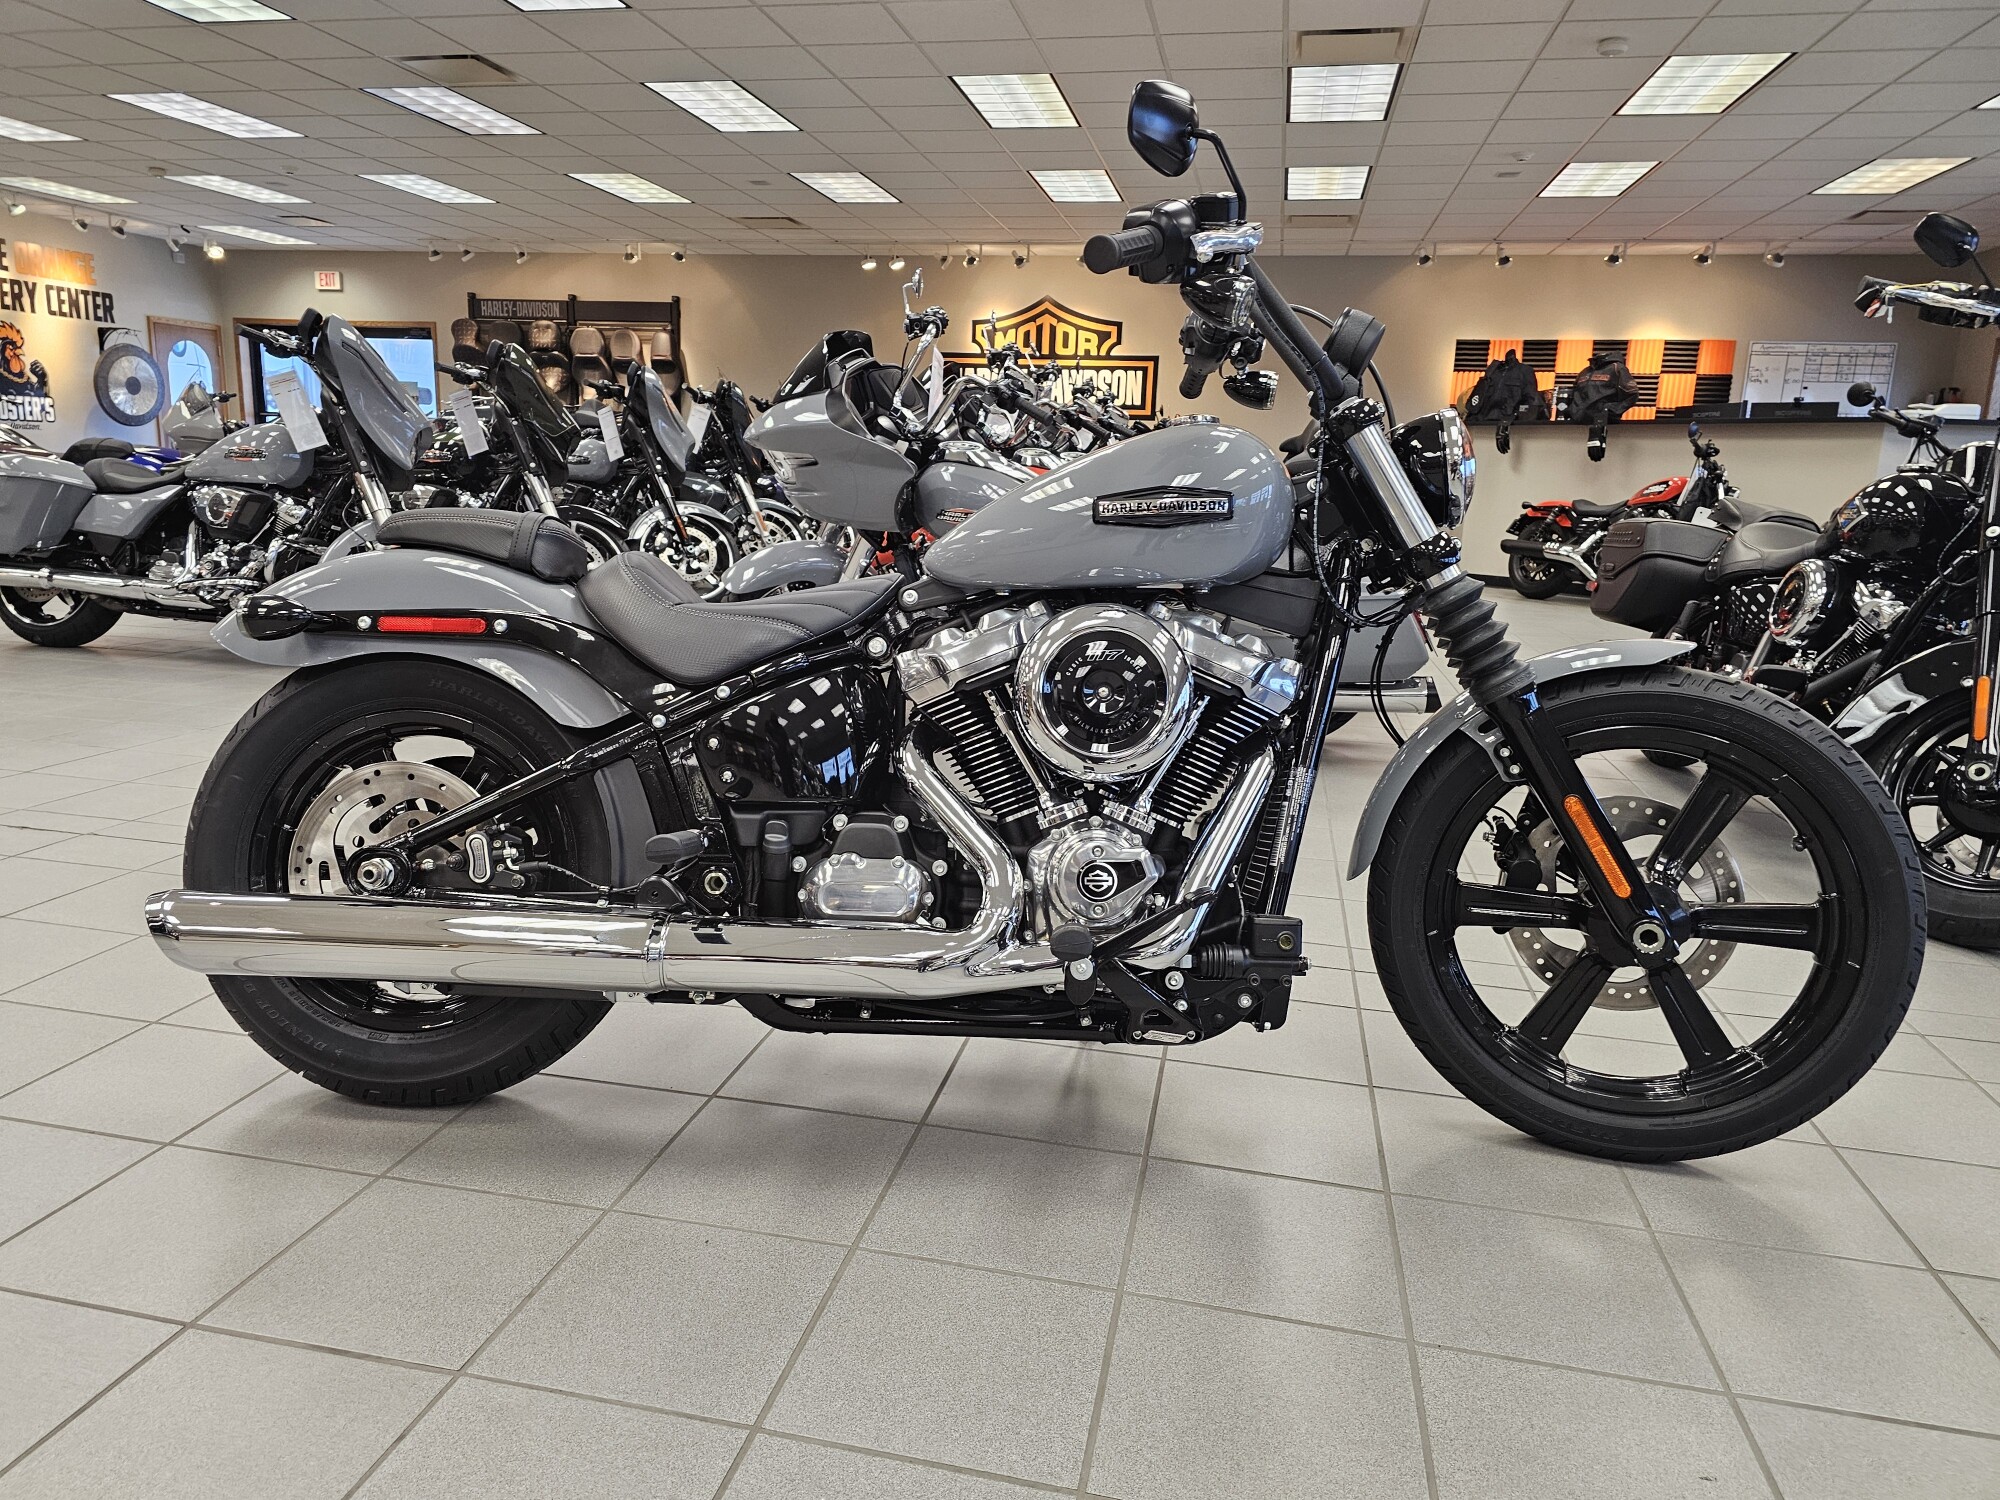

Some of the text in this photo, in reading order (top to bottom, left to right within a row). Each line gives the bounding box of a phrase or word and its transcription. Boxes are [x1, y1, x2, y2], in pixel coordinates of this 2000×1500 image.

[13, 241, 97, 286] ORANGE
[319, 272, 335, 287] EXIT
[45, 284, 116, 324] CENTER
[480, 300, 560, 318] HARLEY-DAVIDSON
[993, 313, 1100, 356] MOTOR
[1101, 499, 1227, 514] HARLEY-DAVIDSON
[1065, 657, 1084, 677] CUBIC
